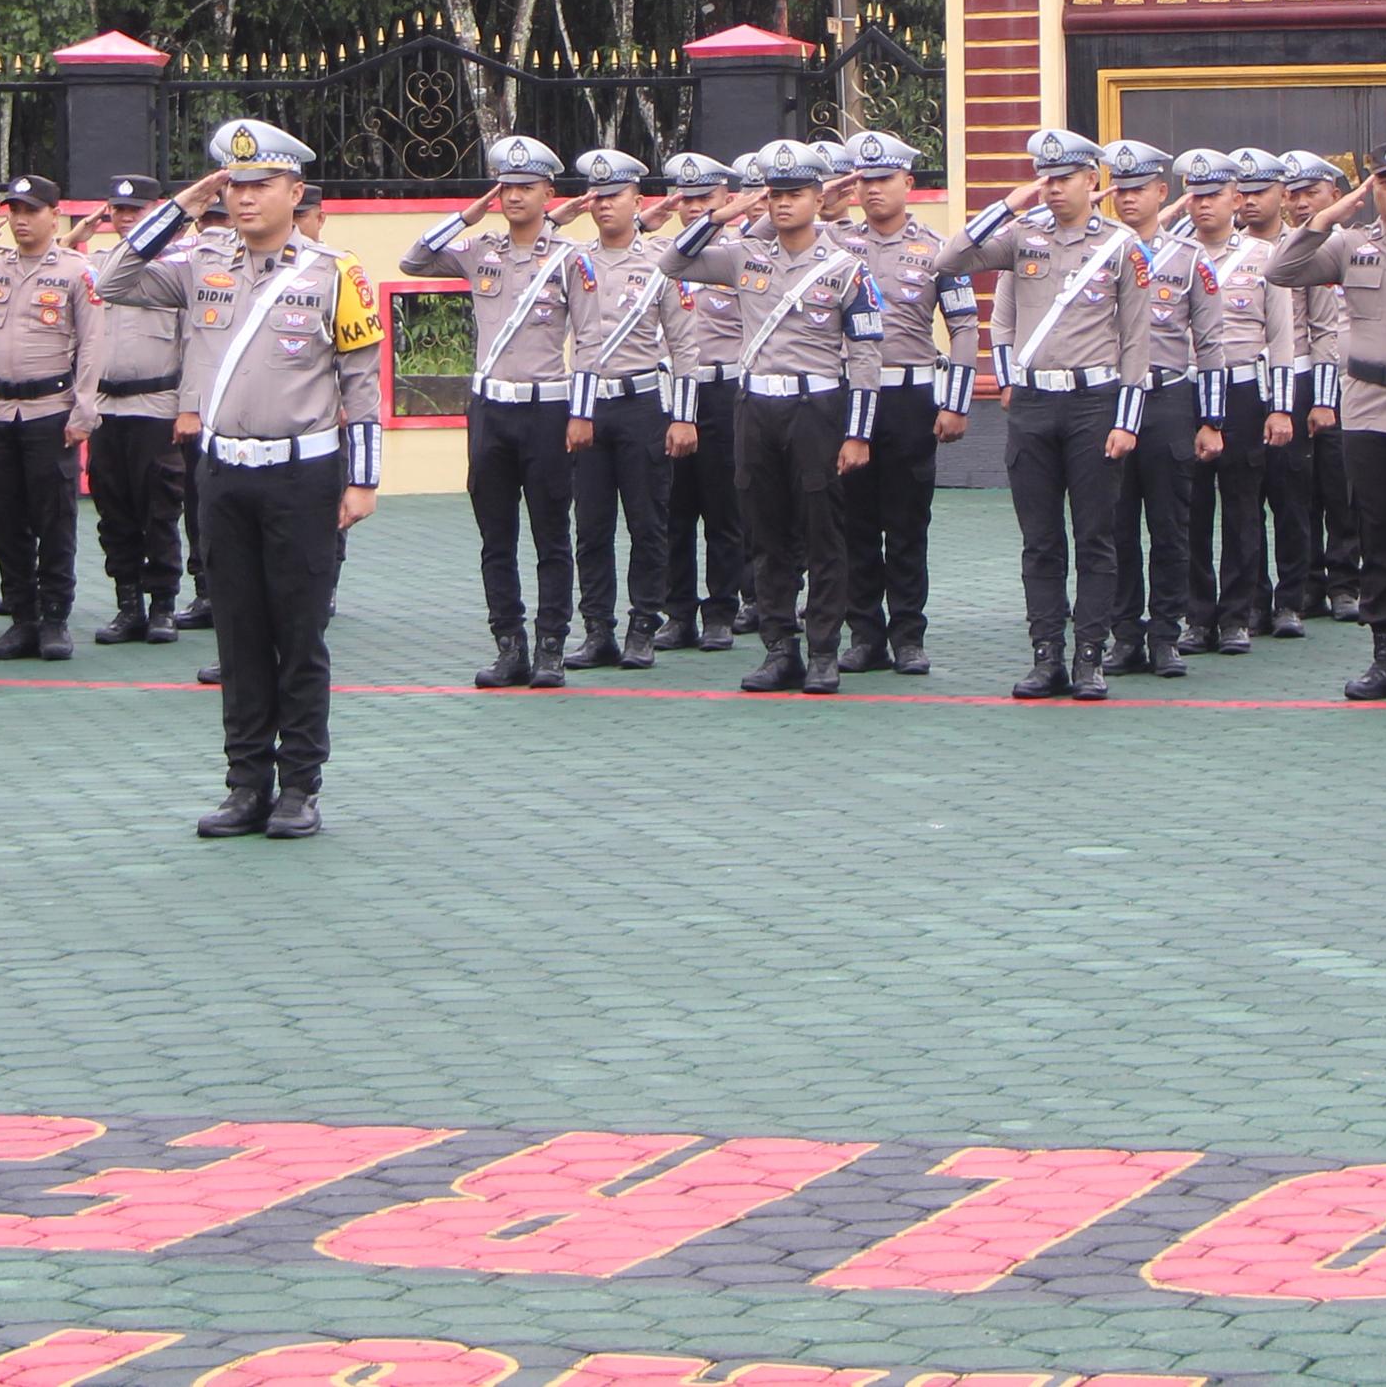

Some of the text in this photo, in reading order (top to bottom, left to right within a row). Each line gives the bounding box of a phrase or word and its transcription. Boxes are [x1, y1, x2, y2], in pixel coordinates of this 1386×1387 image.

[899, 255, 933, 269] POLRI
[1350, 255, 1380, 266] HERI
[477, 265, 501, 278] DENI
[37, 278, 69, 288] POLRI
[816, 276, 841, 290] OLRI
[197, 289, 234, 304] DIDIN
[274, 293, 321, 308] POLRI
[340, 325, 367, 344] KA
